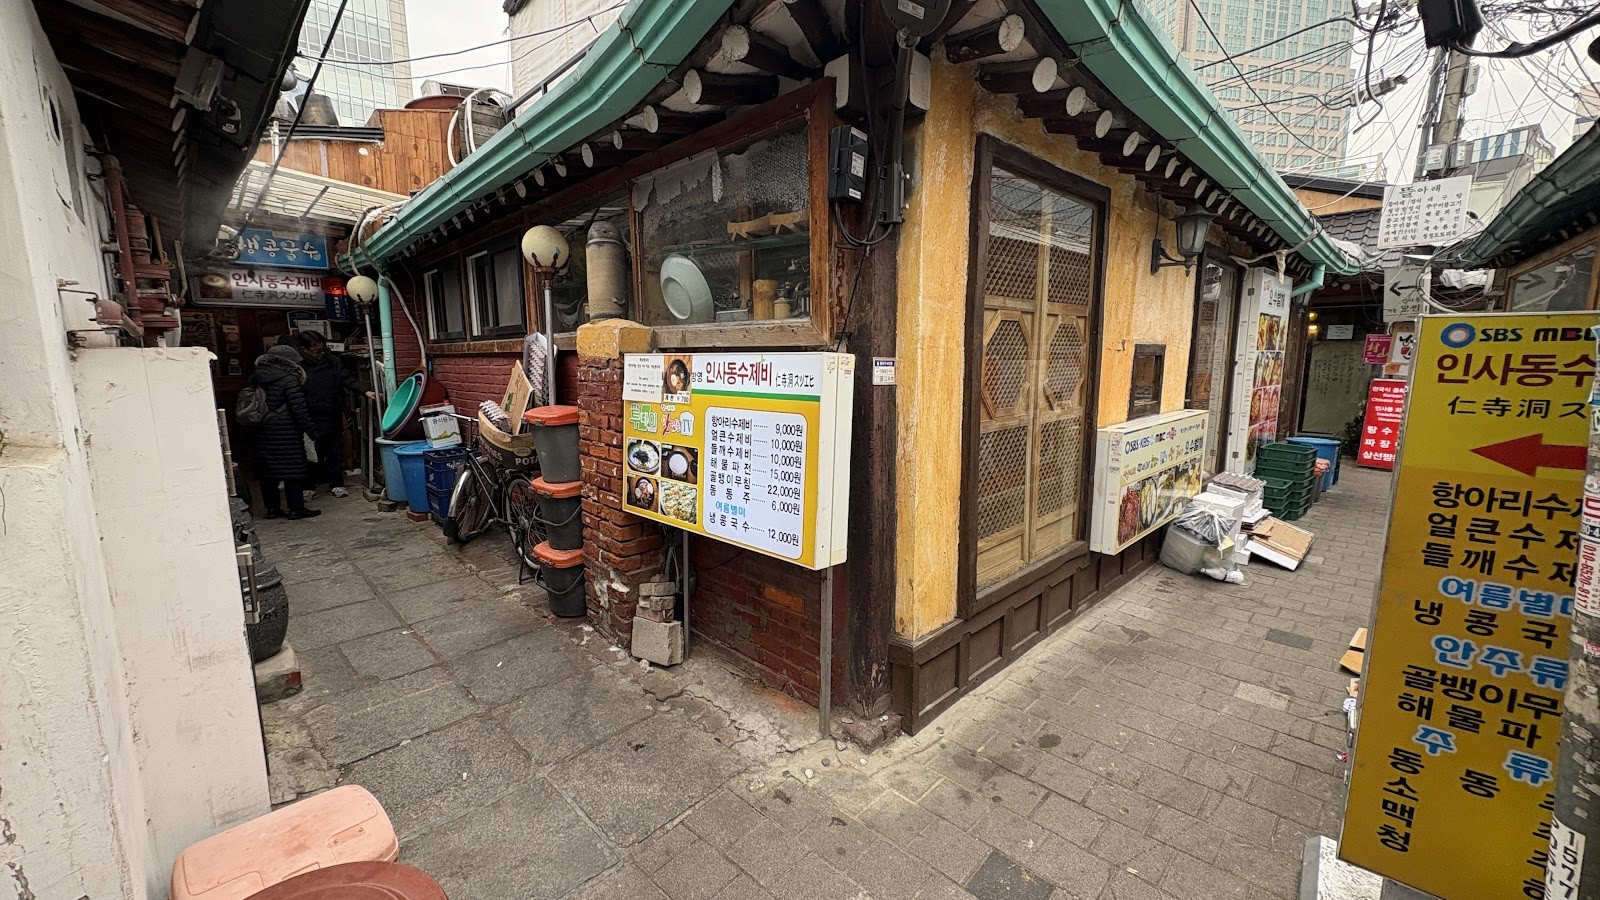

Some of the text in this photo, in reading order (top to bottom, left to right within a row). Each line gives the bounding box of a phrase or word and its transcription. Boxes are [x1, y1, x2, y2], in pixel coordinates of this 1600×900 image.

[232, 272, 324, 290] 인사동수제비
[1479, 327, 1524, 342] SBS
[705, 361, 773, 387] 인사동수제비
[1437, 353, 1596, 388] 인사동수
[711, 415, 803, 437] 항아리수제비 9,000원
[711, 429, 803, 453] 얼큰수제비 10,000원
[710, 443, 802, 469] 들깨수제비 10,000원
[710, 457, 801, 485] 해물파전 15,000원
[710, 470, 801, 500] 골뱅이무침 22,000원
[715, 500, 746, 518] 여름별미
[771, 500, 800, 516] 6,000원
[709, 511, 799, 547] 냉콩국수 12,000원
[1576, 544, 1597, 610] 010-6520-8117
[1433, 635, 1569, 690] 안주류
[1401, 664, 1564, 720] 골뱅이무
[1398, 692, 1560, 749] 해물파
